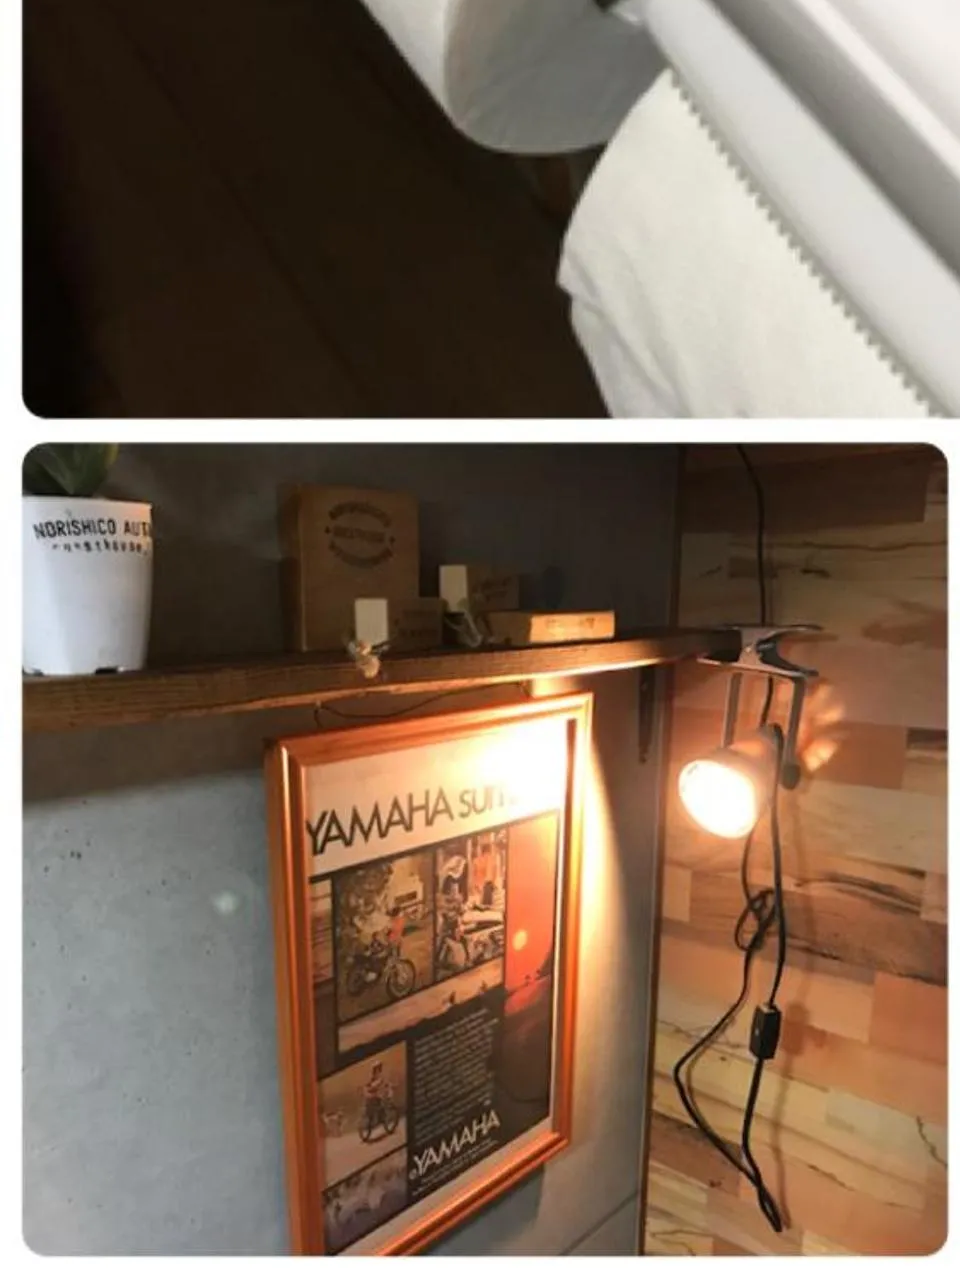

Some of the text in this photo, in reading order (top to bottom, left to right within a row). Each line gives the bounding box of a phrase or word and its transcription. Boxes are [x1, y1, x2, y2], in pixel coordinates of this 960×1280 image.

[33, 518, 117, 538] NORISHICO
[306, 786, 454, 856] YAMAHA
[413, 1109, 501, 1177] YAMAHA
